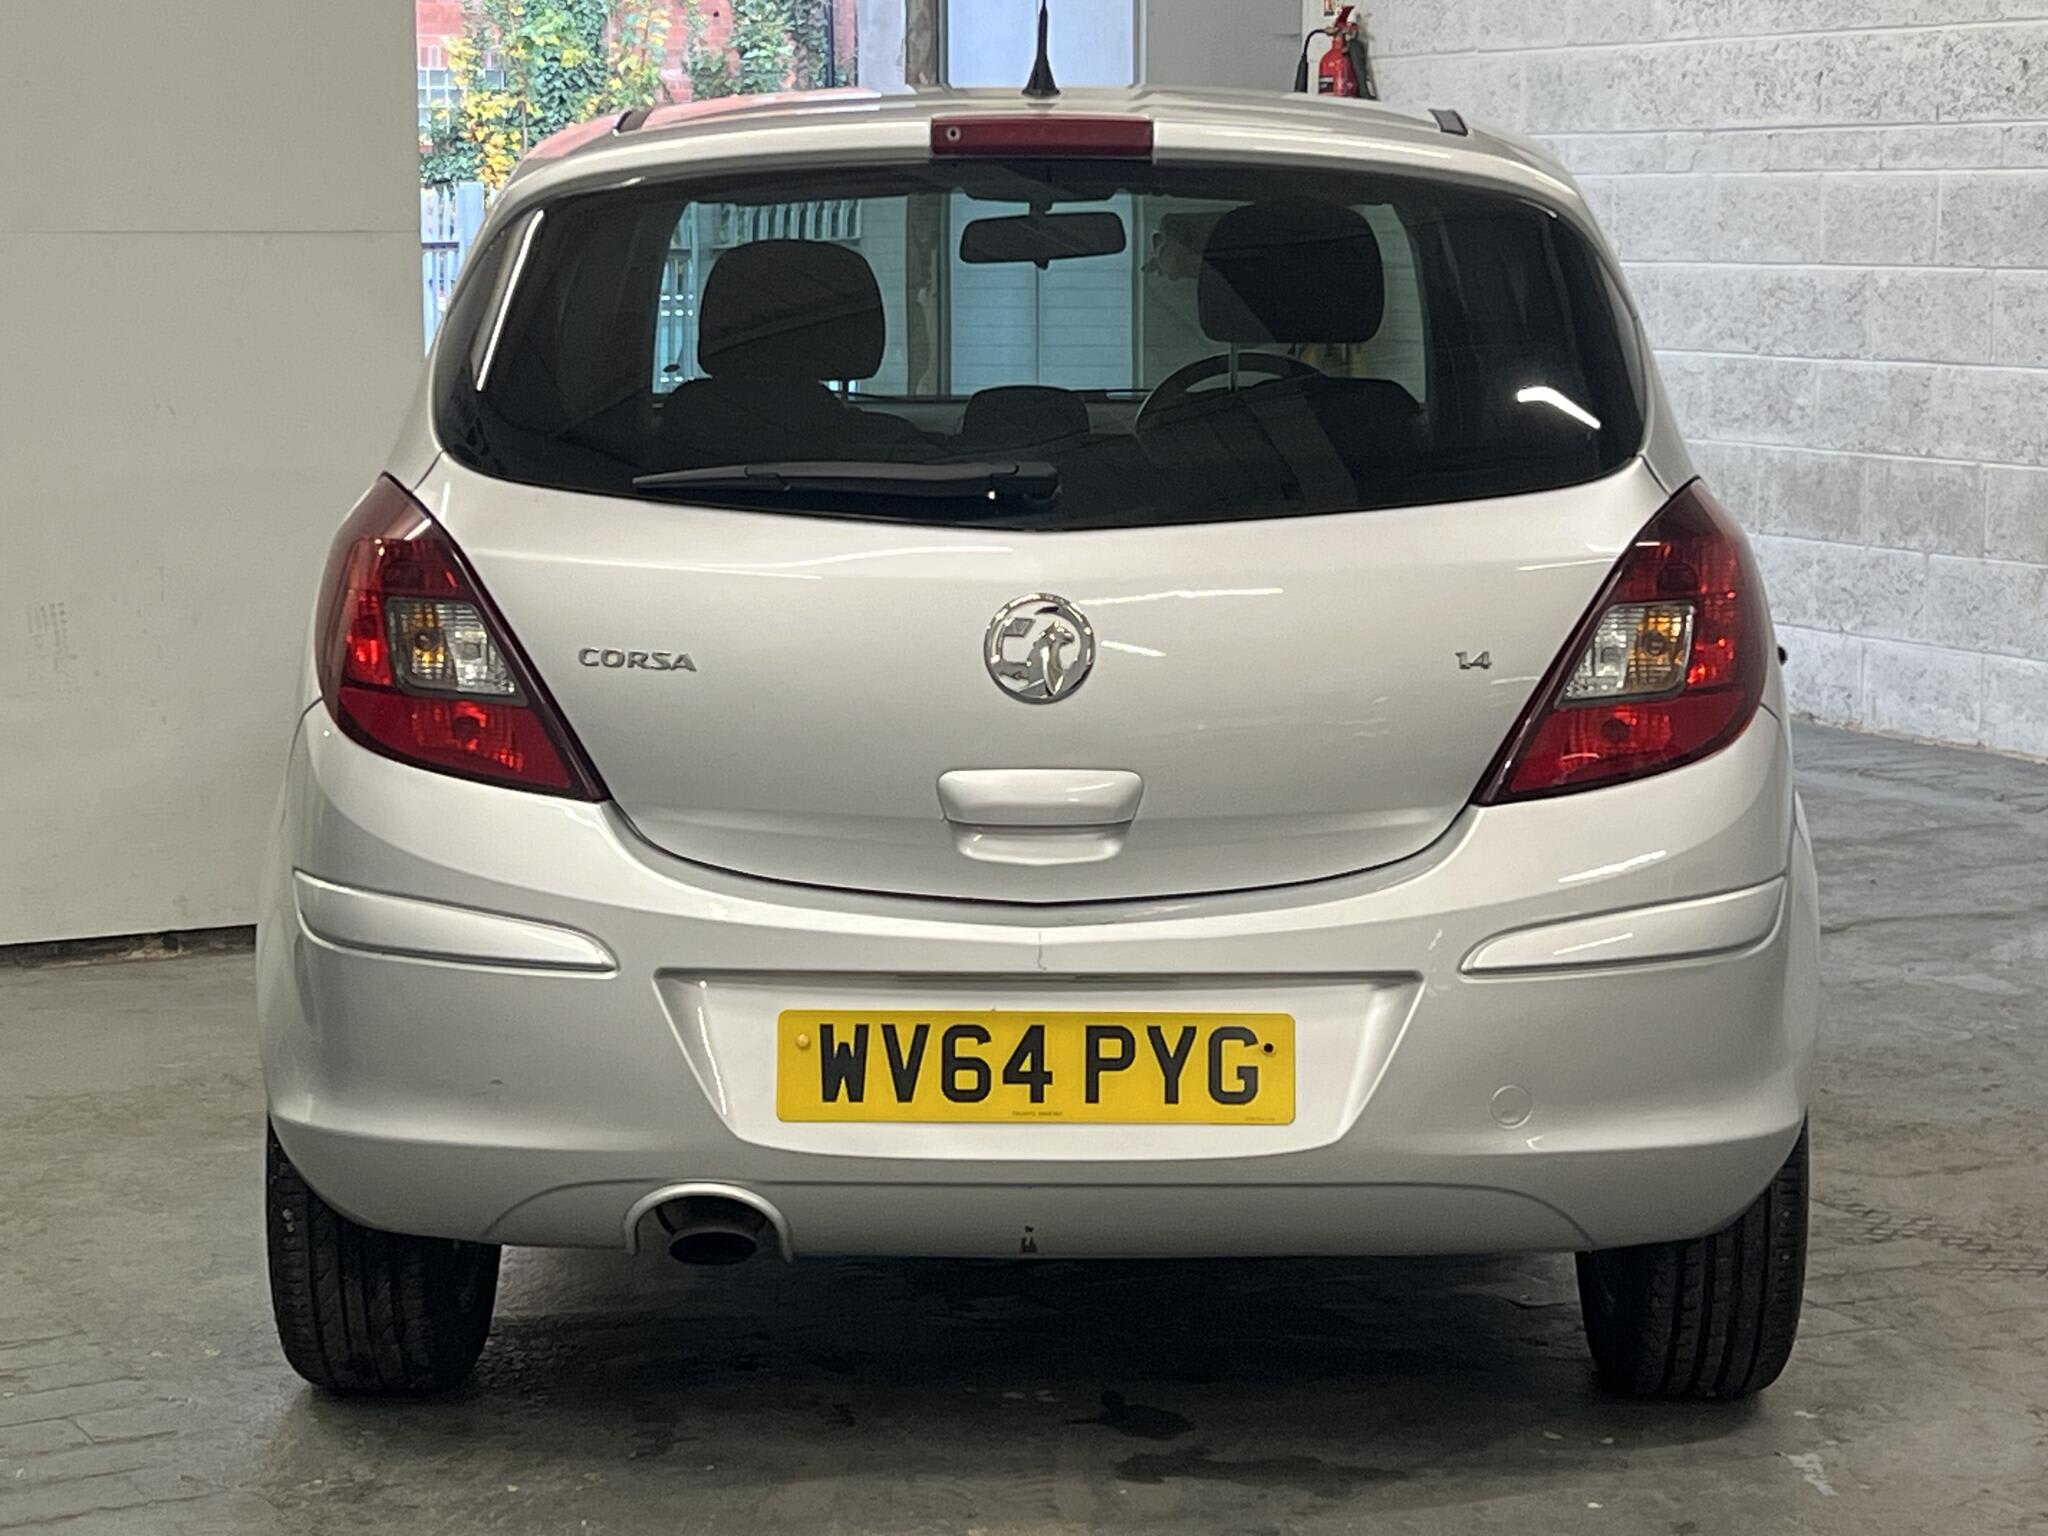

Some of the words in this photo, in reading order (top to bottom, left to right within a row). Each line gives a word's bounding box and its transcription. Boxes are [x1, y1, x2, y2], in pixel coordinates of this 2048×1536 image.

[578, 648, 697, 672] CORSA
[819, 1023, 1053, 1104] WV64
[1085, 1025, 1259, 1105] PYG
